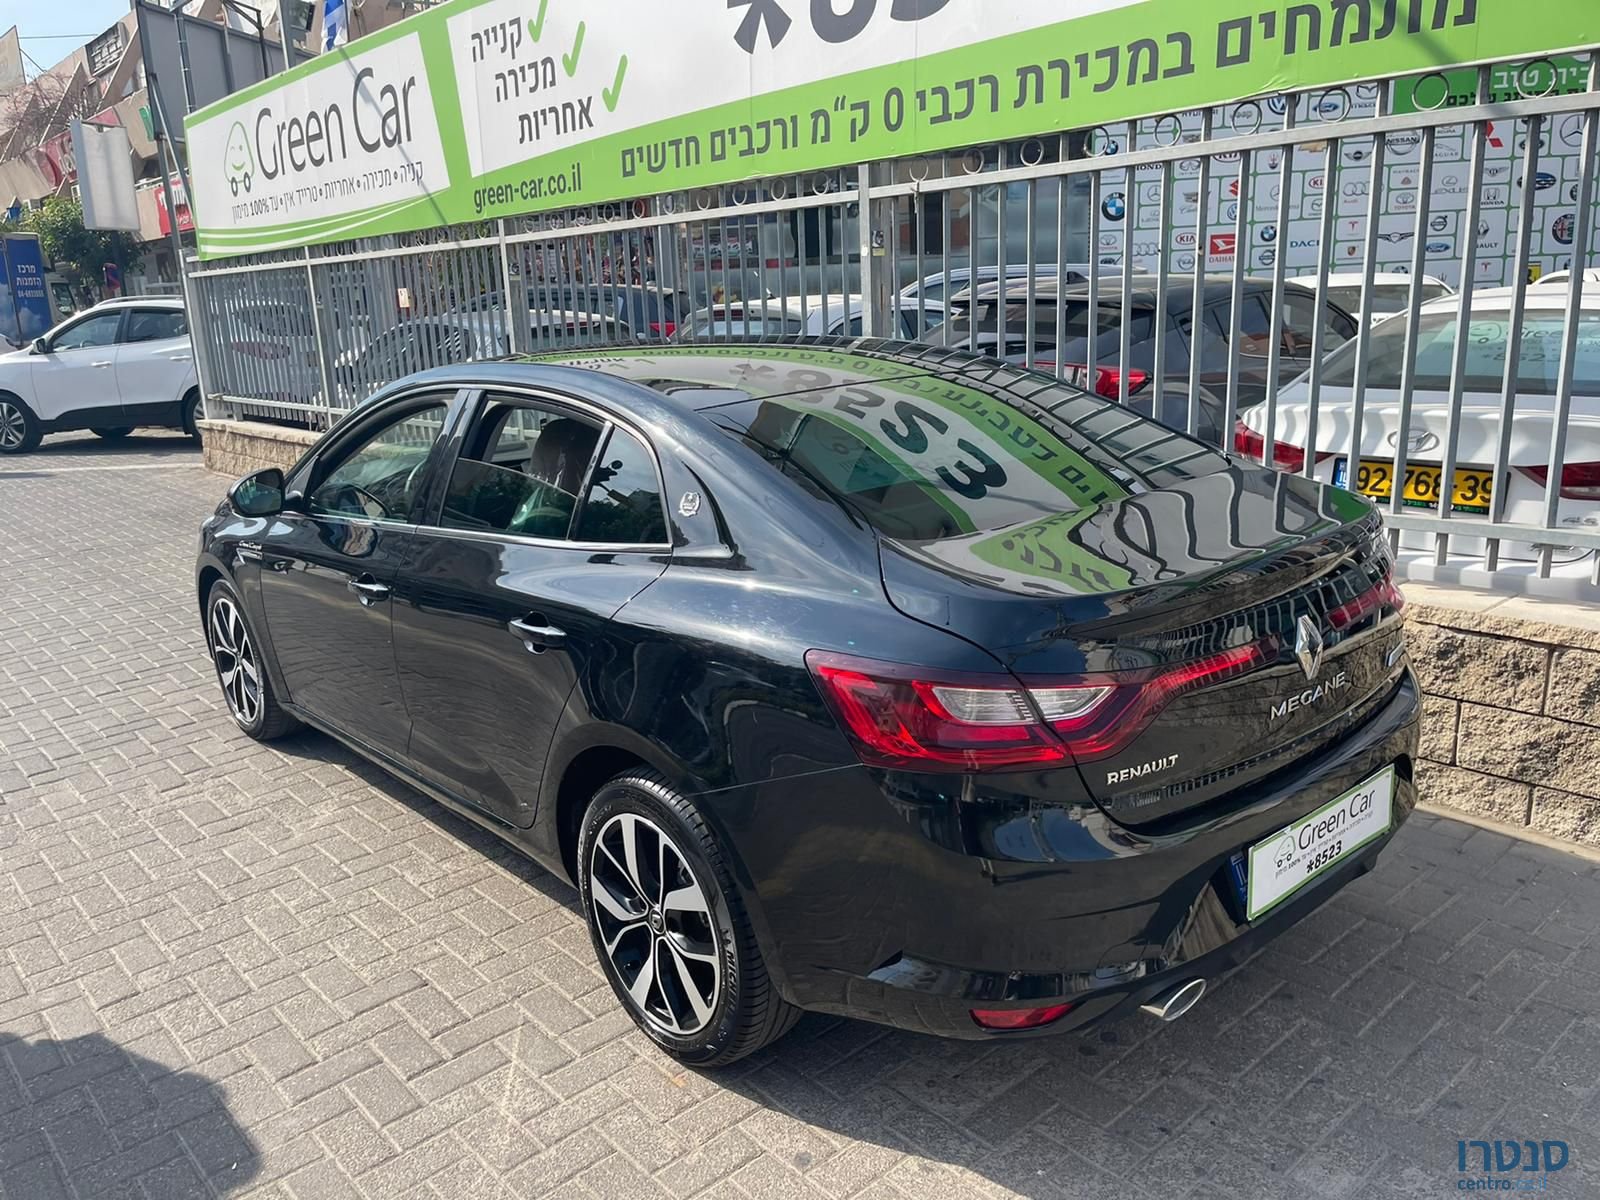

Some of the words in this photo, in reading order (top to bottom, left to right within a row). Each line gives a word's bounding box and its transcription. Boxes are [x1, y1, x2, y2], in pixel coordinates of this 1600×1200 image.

[471, 17, 522, 62] קנייה
[495, 56, 556, 102] מכירה
[1013, 31, 1195, 109] במכירת
[519, 96, 594, 144] אחריות
[883, 86, 904, 132] 0
[915, 74, 999, 125] רכבי
[256, 107, 347, 180] Green
[353, 67, 415, 153] Car
[710, 114, 798, 163] ורכבים
[363, 168, 391, 191] מכירה
[400, 161, 423, 186] קניה
[621, 135, 700, 178] חדשים
[251, 198, 270, 216] 100%
[324, 177, 356, 199] אחריות
[474, 162, 582, 213] green-car.co.il
[1289, 239, 1320, 248] DACI
[17, 264, 36, 273] מרכז
[1269, 672, 1347, 721] MEGANE
[1106, 754, 1178, 785] RENAULT
[1298, 808, 1346, 850] Green
[1349, 789, 1376, 819] Car
